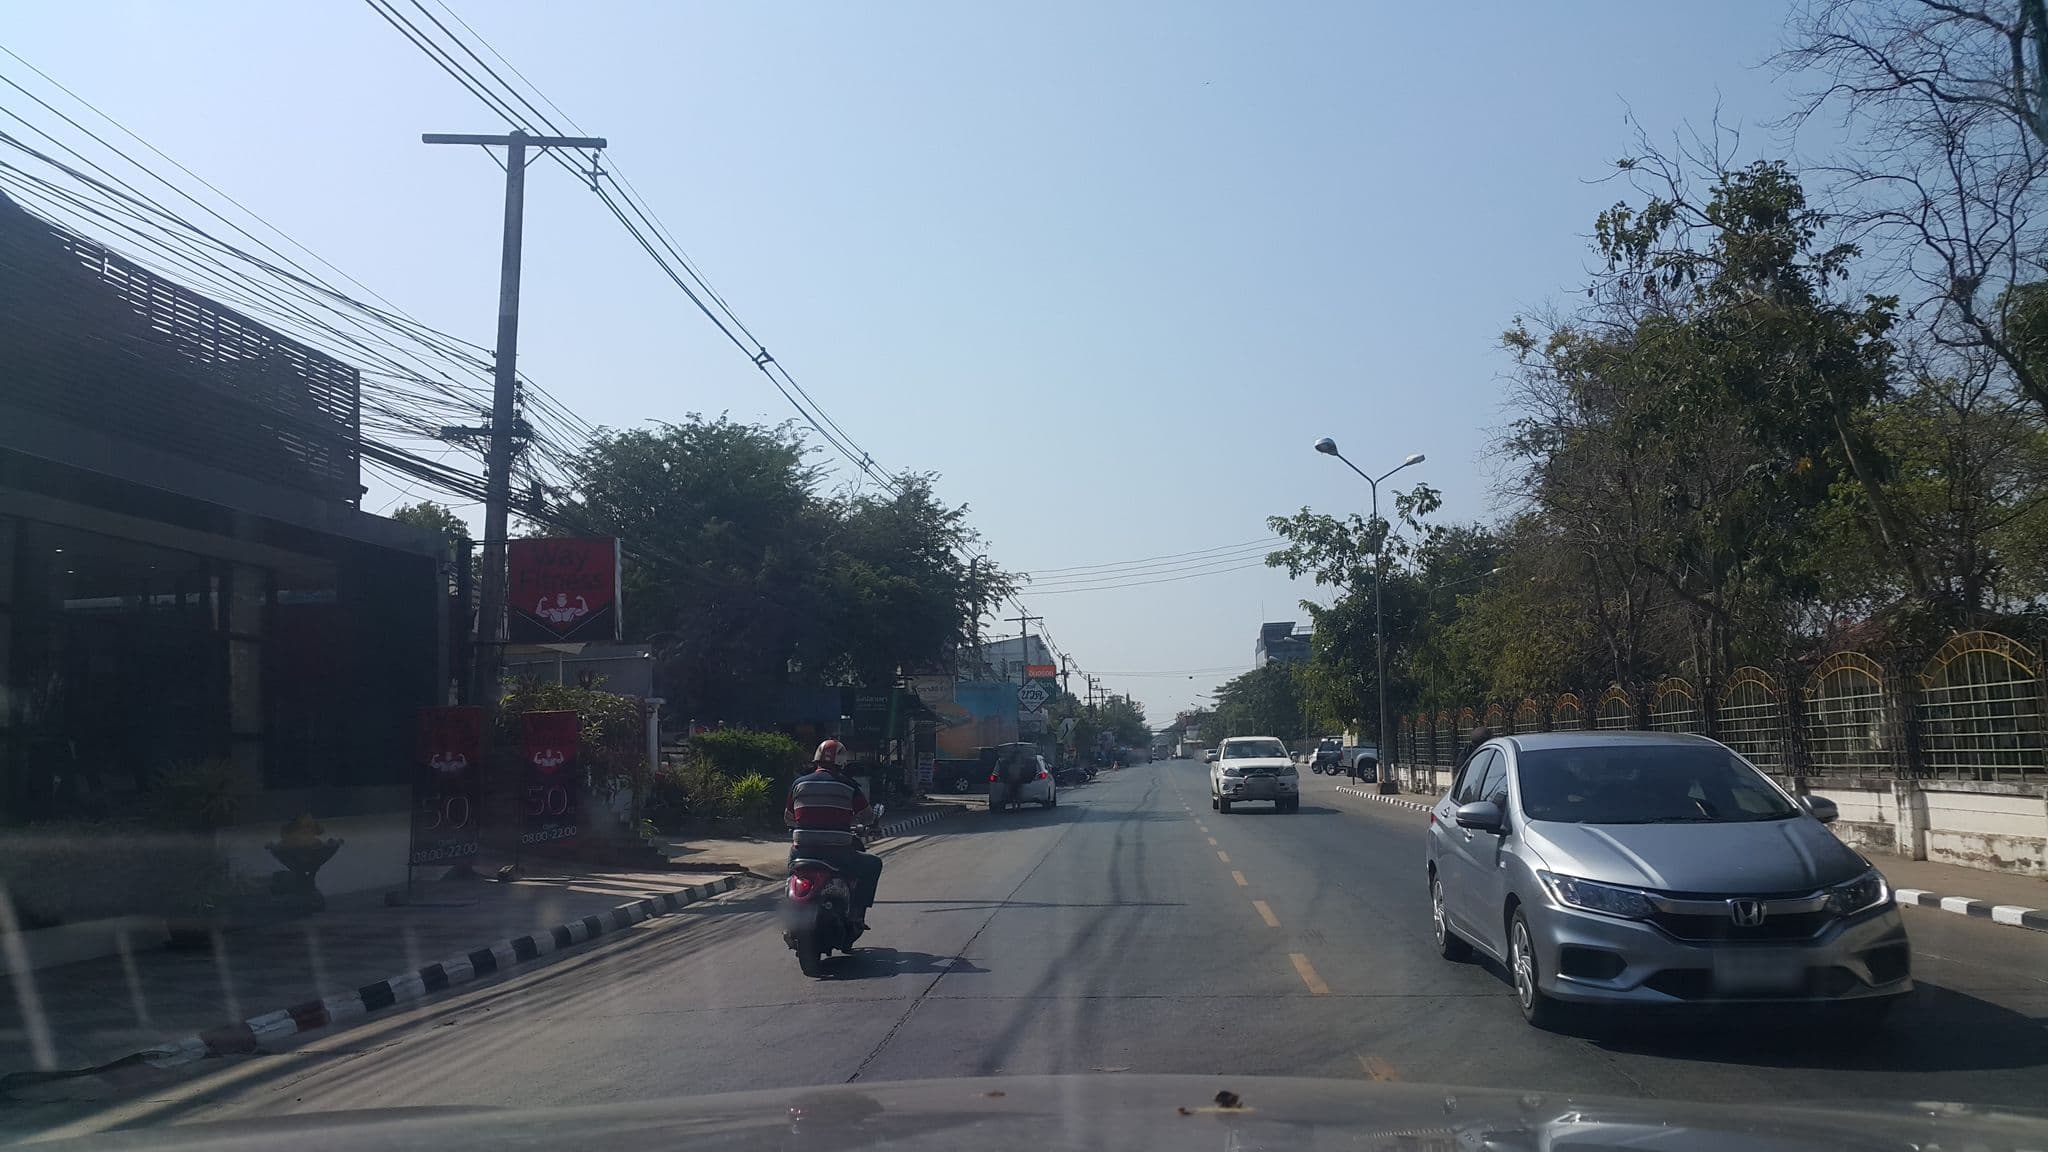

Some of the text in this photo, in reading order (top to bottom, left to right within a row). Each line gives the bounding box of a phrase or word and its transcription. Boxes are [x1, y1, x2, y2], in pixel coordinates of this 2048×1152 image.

[534, 544, 590, 570] Way
[422, 792, 470, 831] 50
[527, 783, 568, 817] 50
